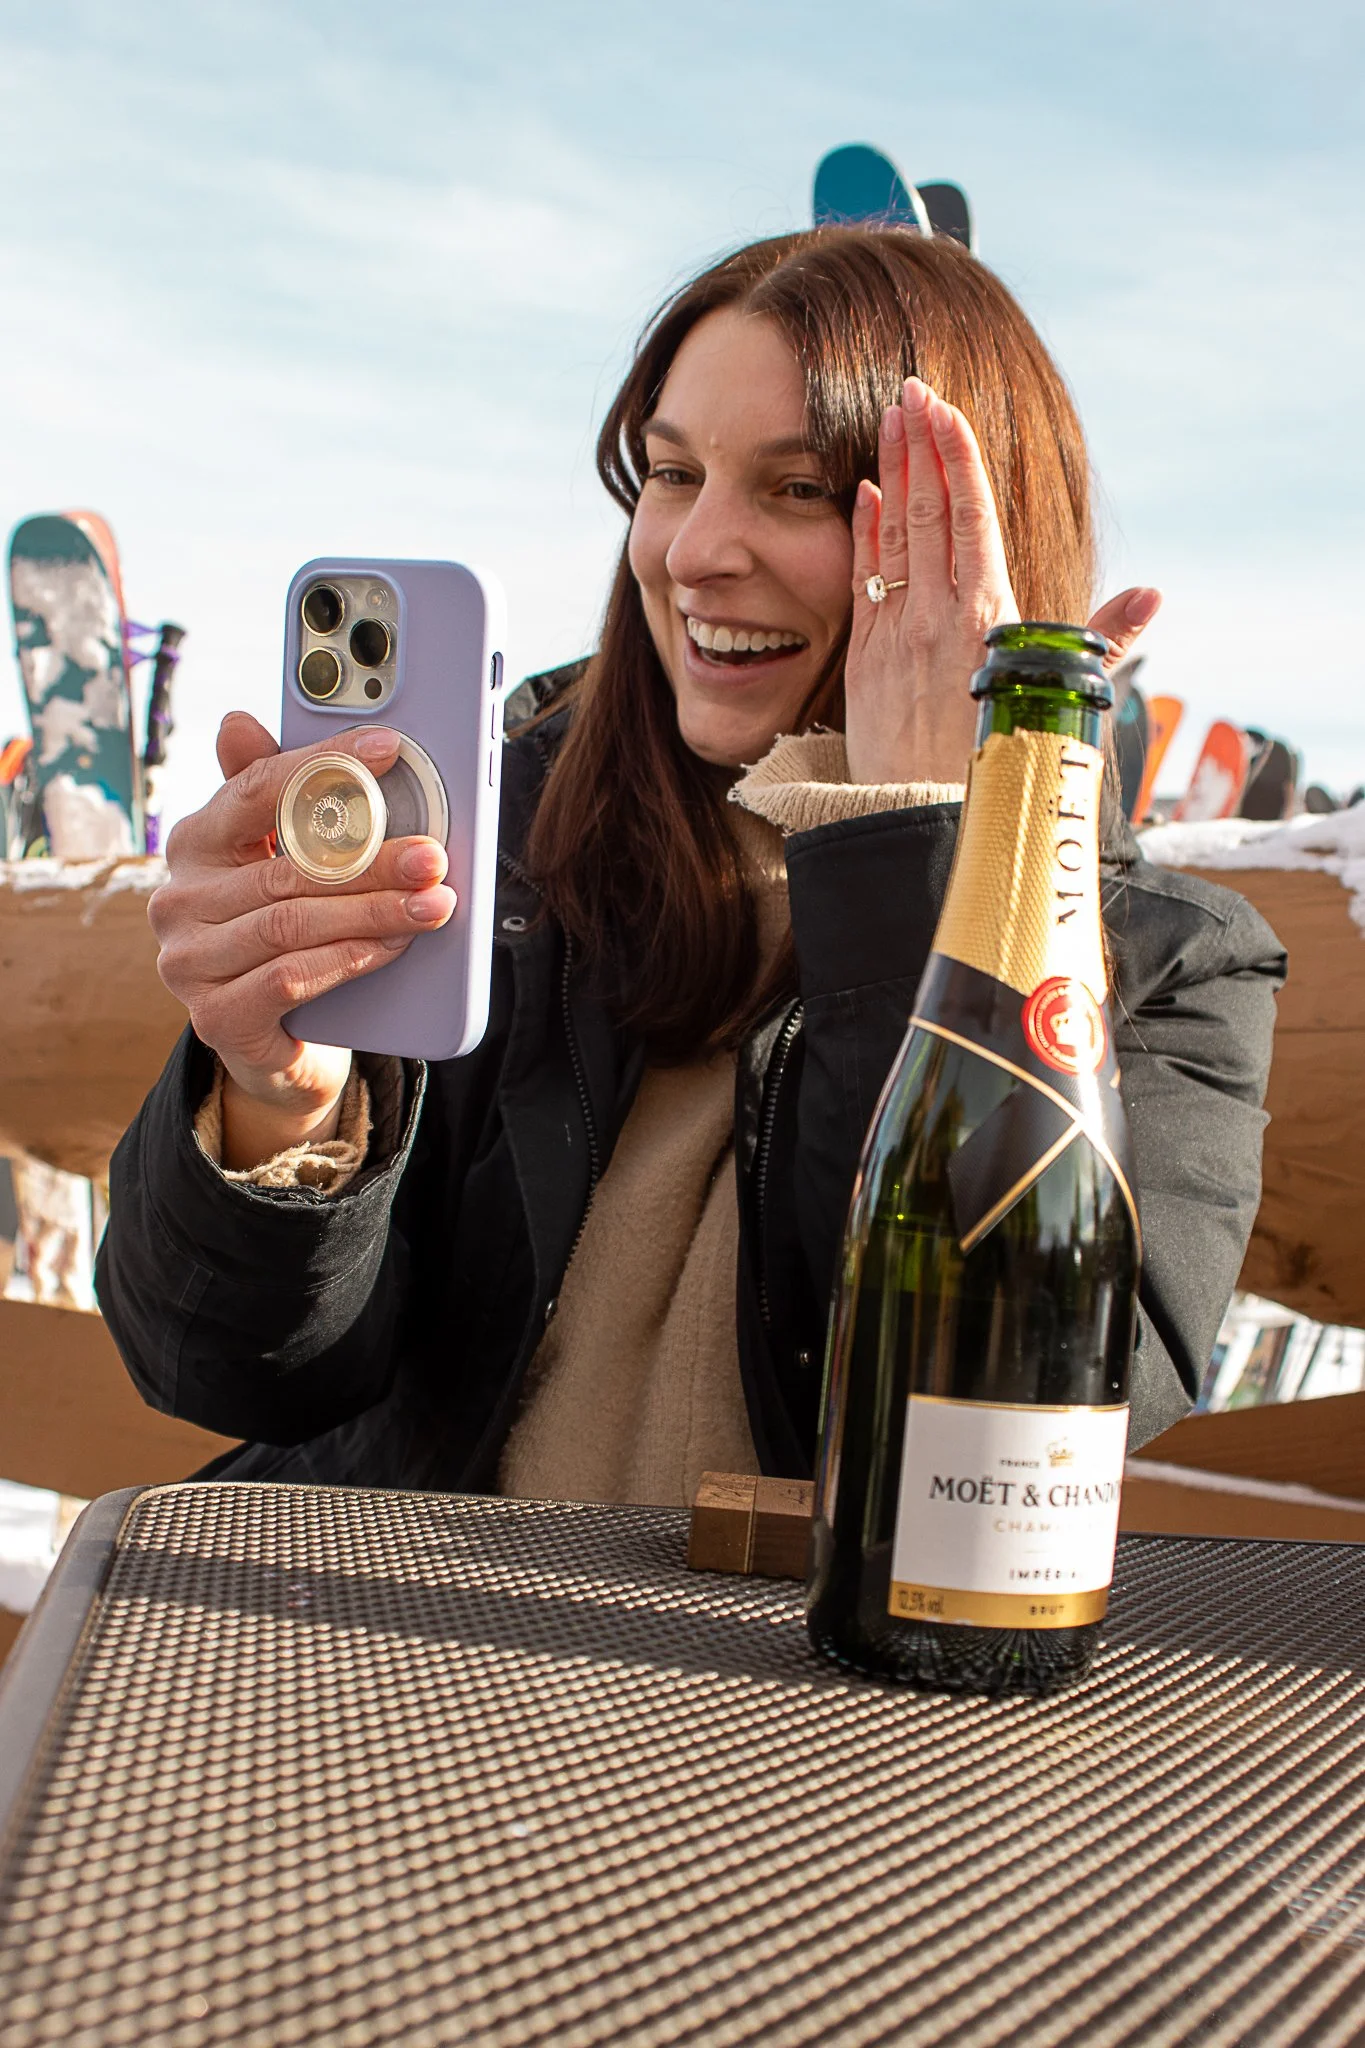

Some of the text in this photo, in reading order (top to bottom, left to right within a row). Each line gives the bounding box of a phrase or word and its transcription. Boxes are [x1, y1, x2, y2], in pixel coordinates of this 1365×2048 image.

[929, 1474, 1119, 1509] MOËT & CHAND
[1029, 1604, 1065, 1616] BRUT
